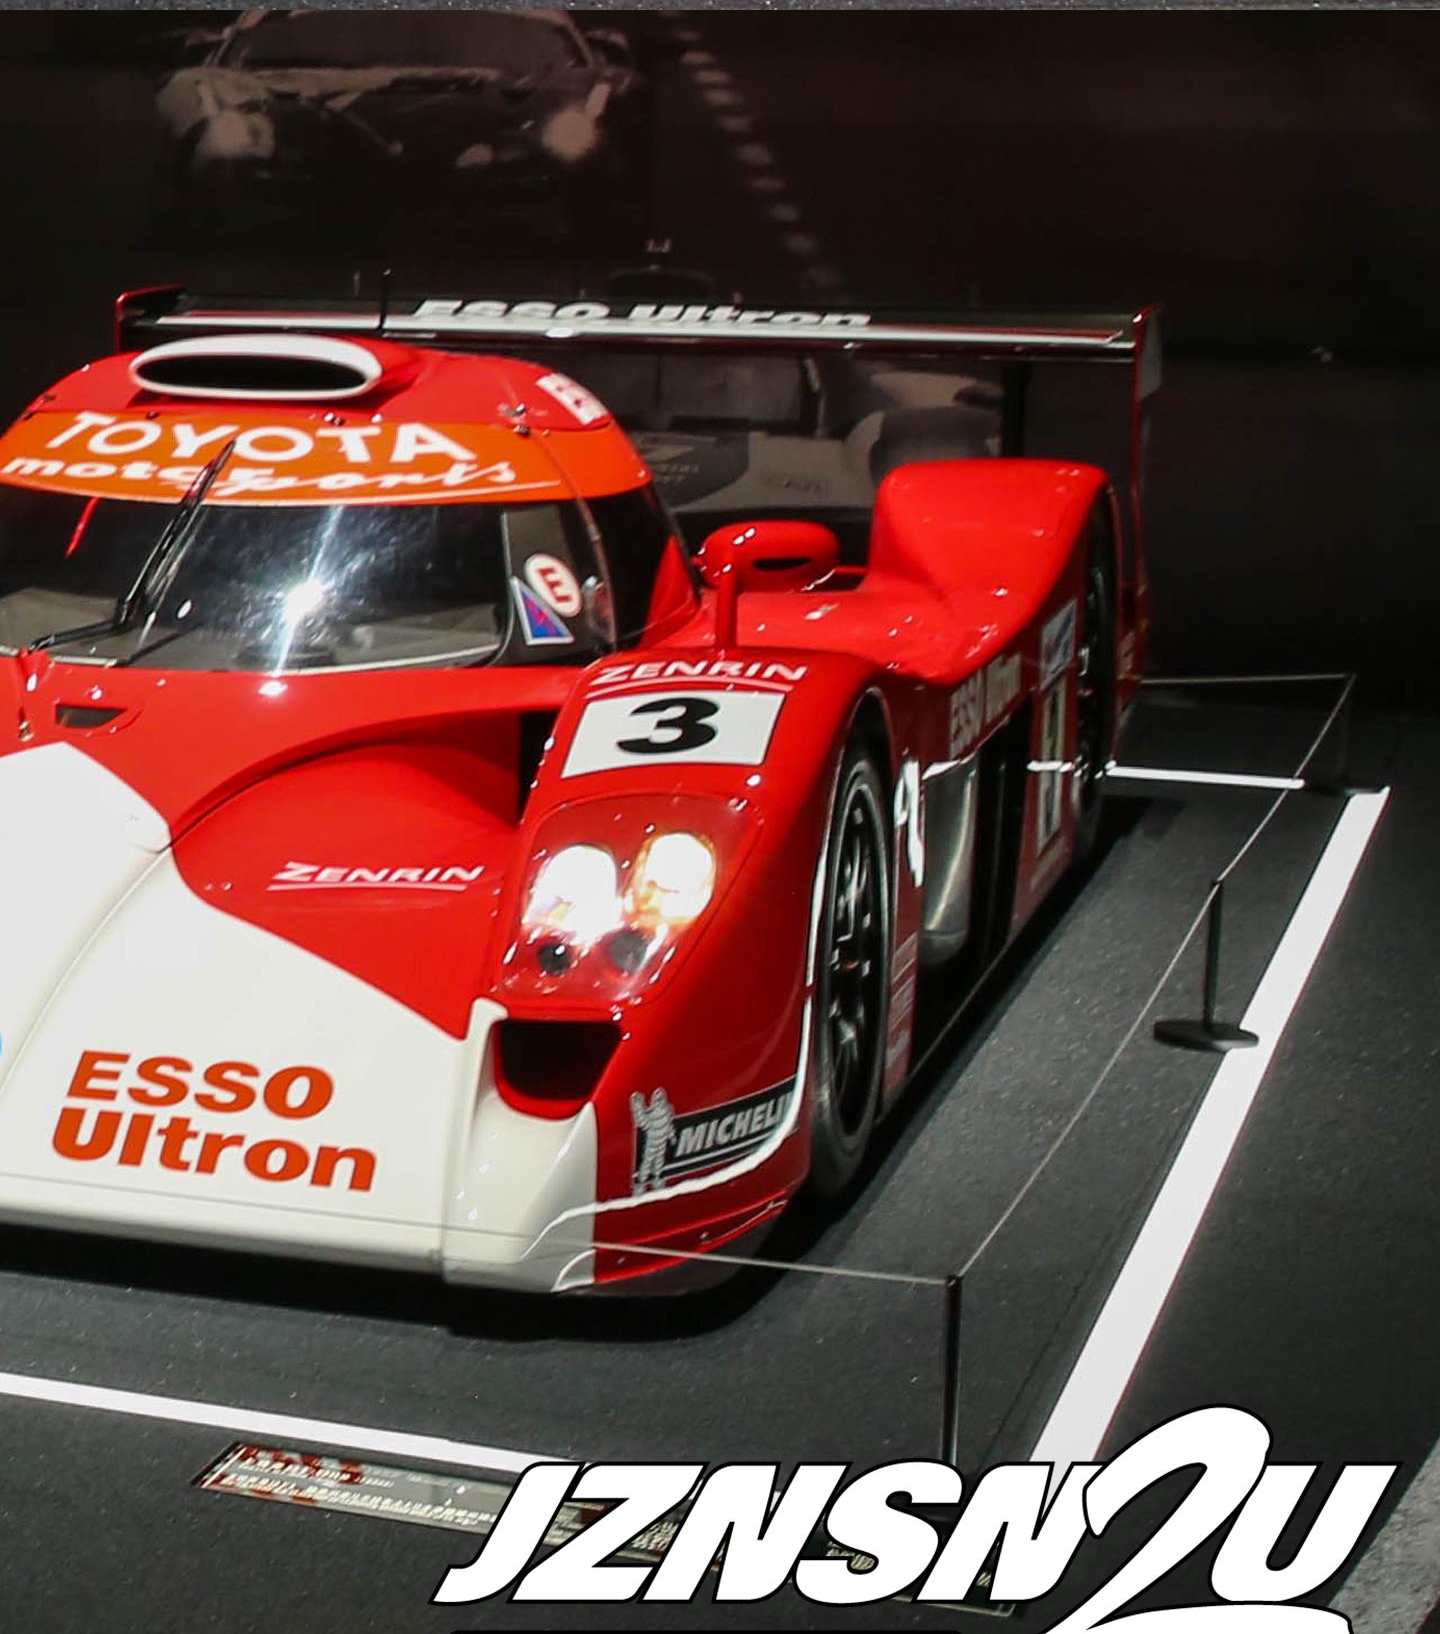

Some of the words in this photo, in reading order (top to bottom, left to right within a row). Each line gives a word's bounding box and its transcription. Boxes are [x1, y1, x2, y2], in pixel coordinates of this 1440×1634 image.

[47, 411, 478, 465] TOYOTA
[594, 659, 810, 685] ZENRIN
[616, 696, 722, 758] 3
[280, 860, 486, 885] ZENRIN
[67, 1048, 337, 1120] ESSO
[49, 1105, 378, 1194] Ultron
